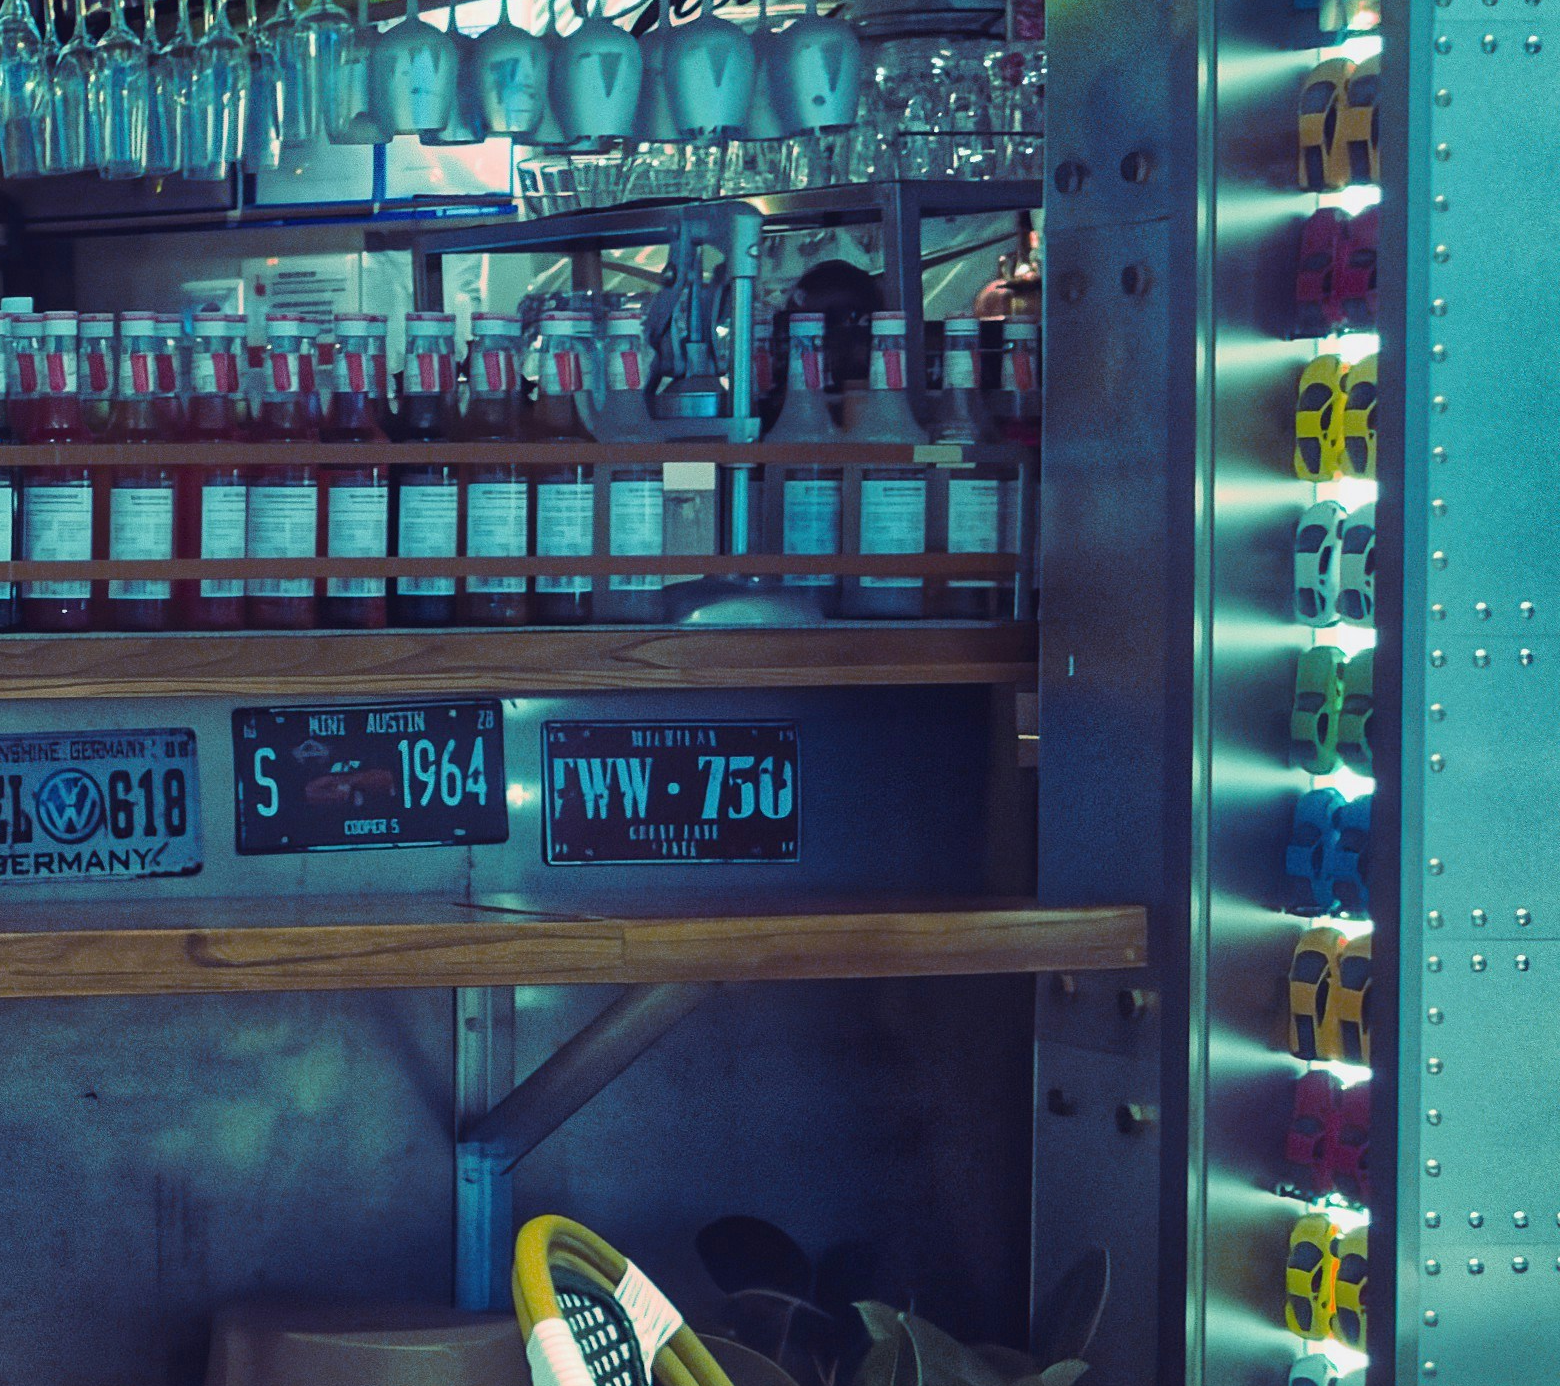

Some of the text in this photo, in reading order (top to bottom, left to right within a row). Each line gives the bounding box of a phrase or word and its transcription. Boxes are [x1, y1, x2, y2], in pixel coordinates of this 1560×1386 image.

[308, 714, 347, 736] MINI
[366, 711, 425, 734] AUSTIN
[108, 768, 187, 840] 618
[253, 736, 488, 817] S 1964
[697, 756, 793, 820] 750
[344, 819, 386, 835] COOPER
